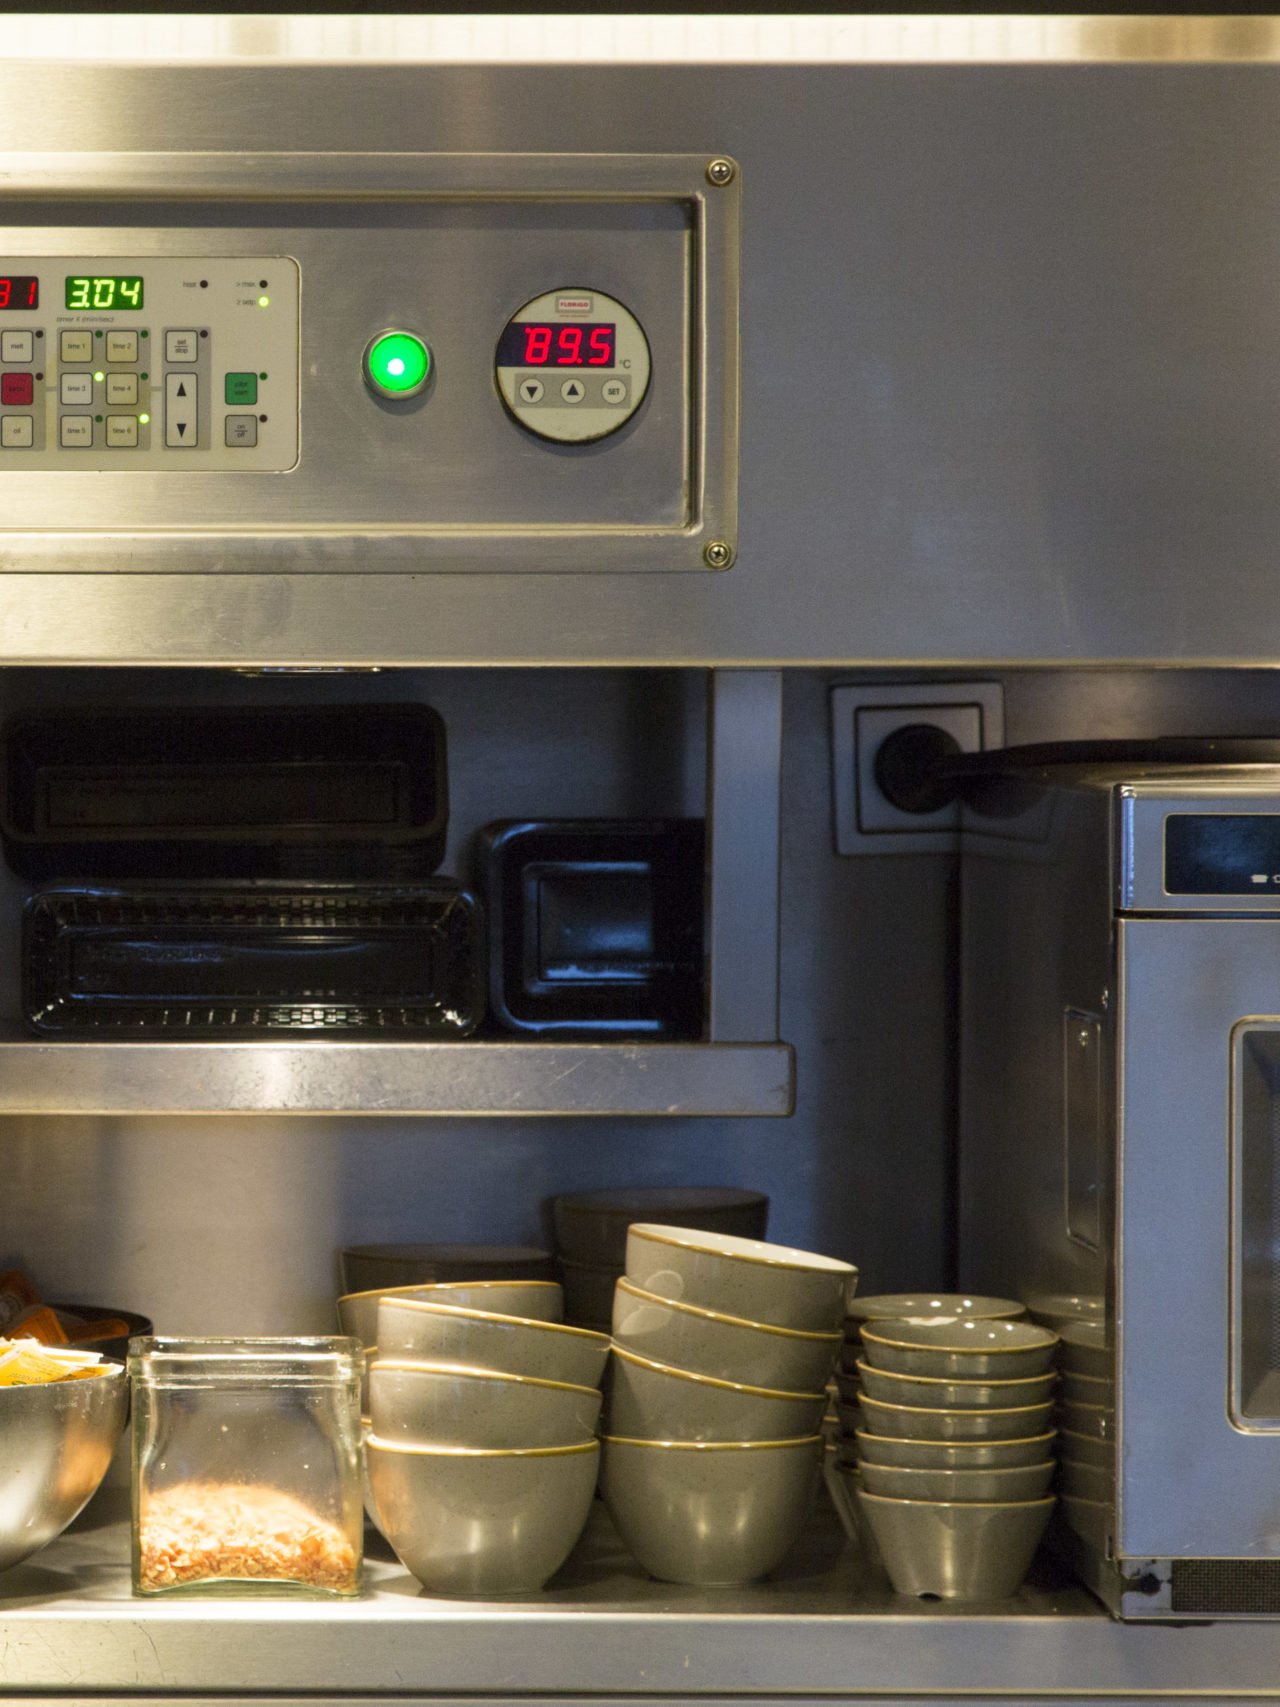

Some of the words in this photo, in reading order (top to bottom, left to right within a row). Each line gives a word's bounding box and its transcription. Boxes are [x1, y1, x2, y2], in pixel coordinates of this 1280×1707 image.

[524, 327, 612, 364] 89.5
[619, 359, 631, 369] °C
[608, 387, 620, 395] SET
